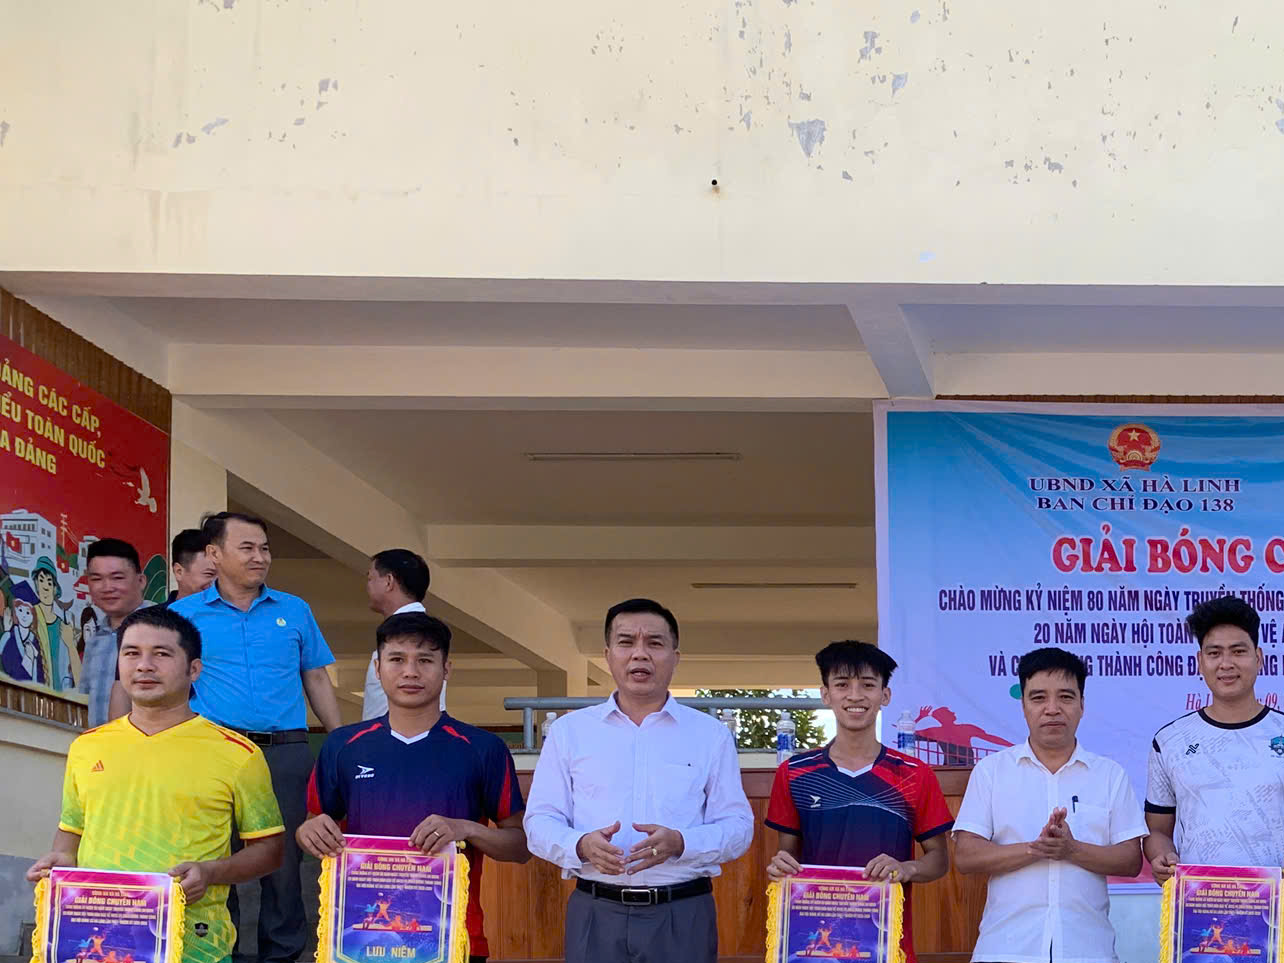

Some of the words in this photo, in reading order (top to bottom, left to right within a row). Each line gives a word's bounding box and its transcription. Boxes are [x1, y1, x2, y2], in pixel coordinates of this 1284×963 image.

[0, 358, 34, 398] ẢNG
[38, 385, 68, 416] CÁC
[0, 391, 21, 423] ỂU
[25, 409, 65, 447] TOÀN
[68, 433, 105, 469] QUỐC
[15, 436, 57, 475] ĐẢNG
[1029, 478, 1094, 492] UBND
[1102, 476, 1133, 492] XÃ
[1142, 475, 1175, 492] HÀ
[1183, 479, 1240, 492] LINH
[1038, 497, 1084, 510] BAN
[1143, 498, 1192, 514] ĐẠO
[1202, 498, 1235, 512] 138
[1052, 524, 1136, 573] GIẢI
[1147, 528, 1254, 574] BÓNG
[939, 585, 976, 611] CHÀO
[980, 585, 1021, 611] MỪNG
[1026, 583, 1043, 611] KỶ
[1047, 586, 1083, 616] NIỆM
[1087, 591, 1103, 611] 80
[1108, 586, 1139, 611] NĂM
[1144, 586, 1180, 611] NGÀY
[1033, 622, 1050, 644] 20
[1055, 618, 1086, 644] NĂM
[1091, 618, 1127, 644] NGÀY
[1132, 619, 1154, 648] HỘI
[1158, 618, 1194, 644] TOÀN
[1261, 618, 1277, 648] VỆ
[989, 651, 1007, 676] VÀ
[1097, 651, 1142, 676] THÀNH
[1146, 651, 1183, 676] CÔNG
[1257, 655, 1278, 676] NG
[1185, 693, 1201, 710] Hà
[1265, 693, 1280, 711] 09,
